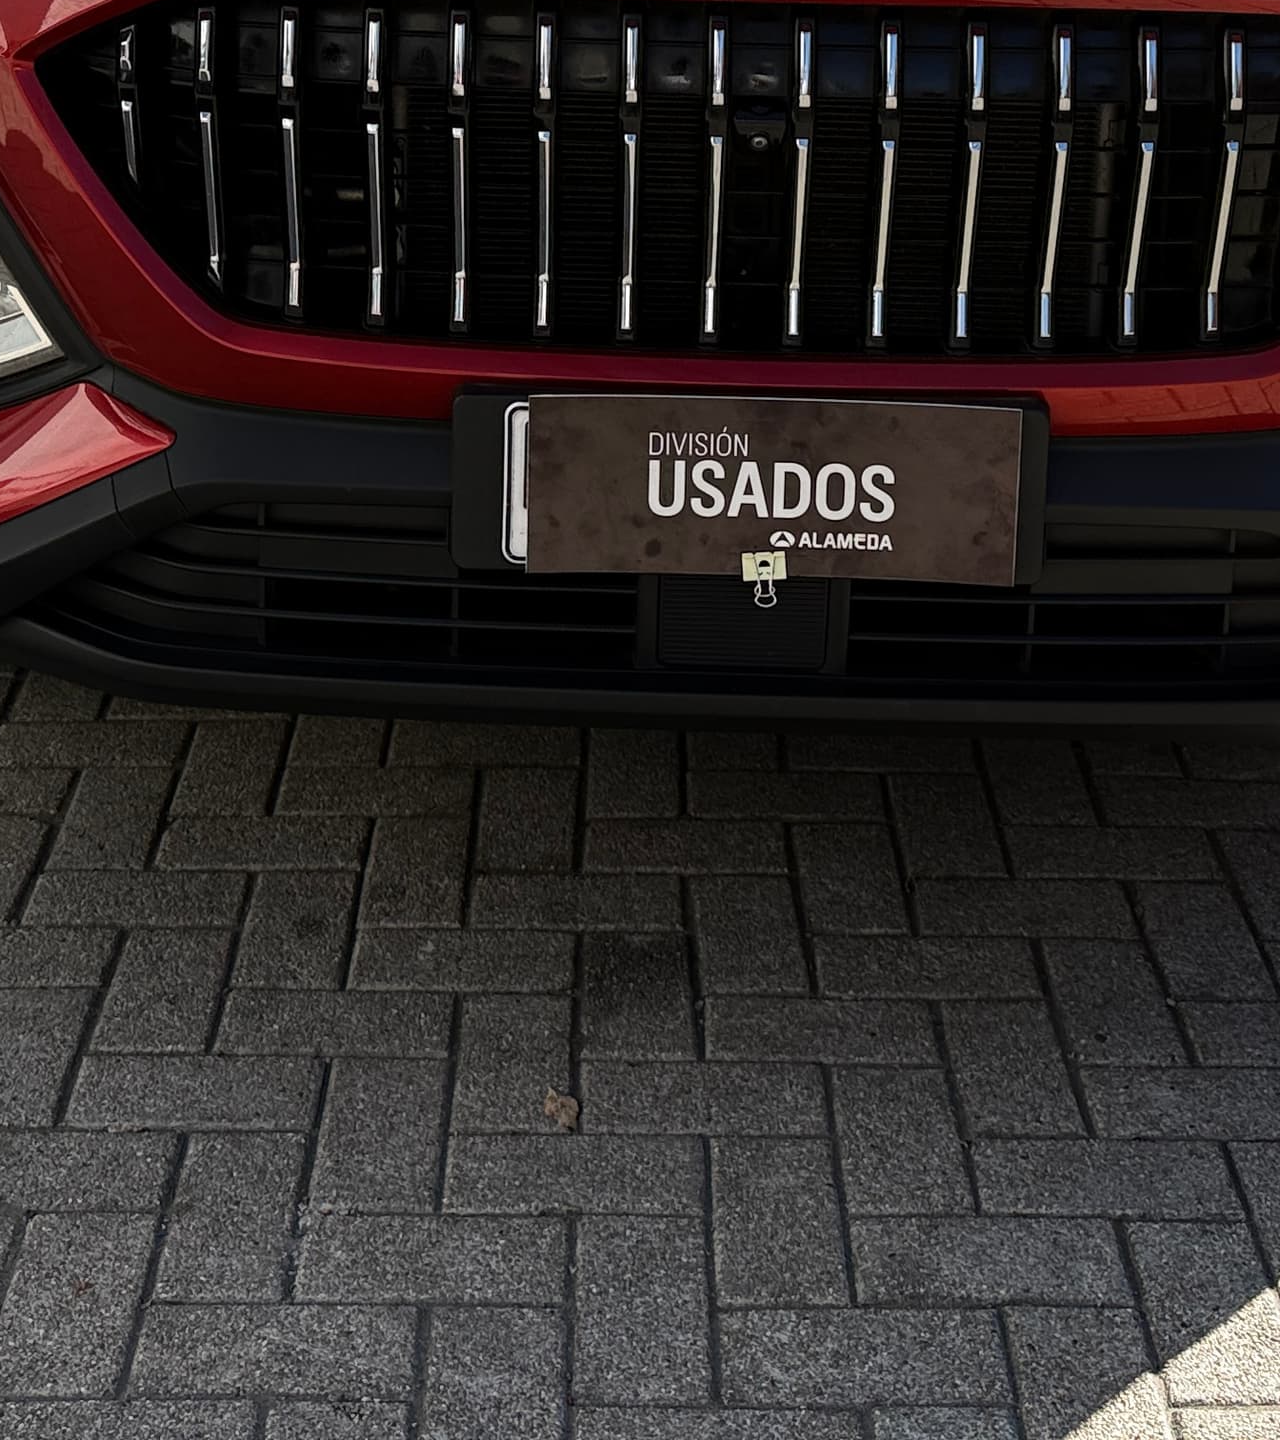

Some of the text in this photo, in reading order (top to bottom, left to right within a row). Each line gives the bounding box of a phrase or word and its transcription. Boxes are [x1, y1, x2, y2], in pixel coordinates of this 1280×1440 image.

[648, 425, 750, 458] DIVISIÓN
[647, 459, 896, 524] USADOS
[798, 531, 894, 552] ALAMEDA
